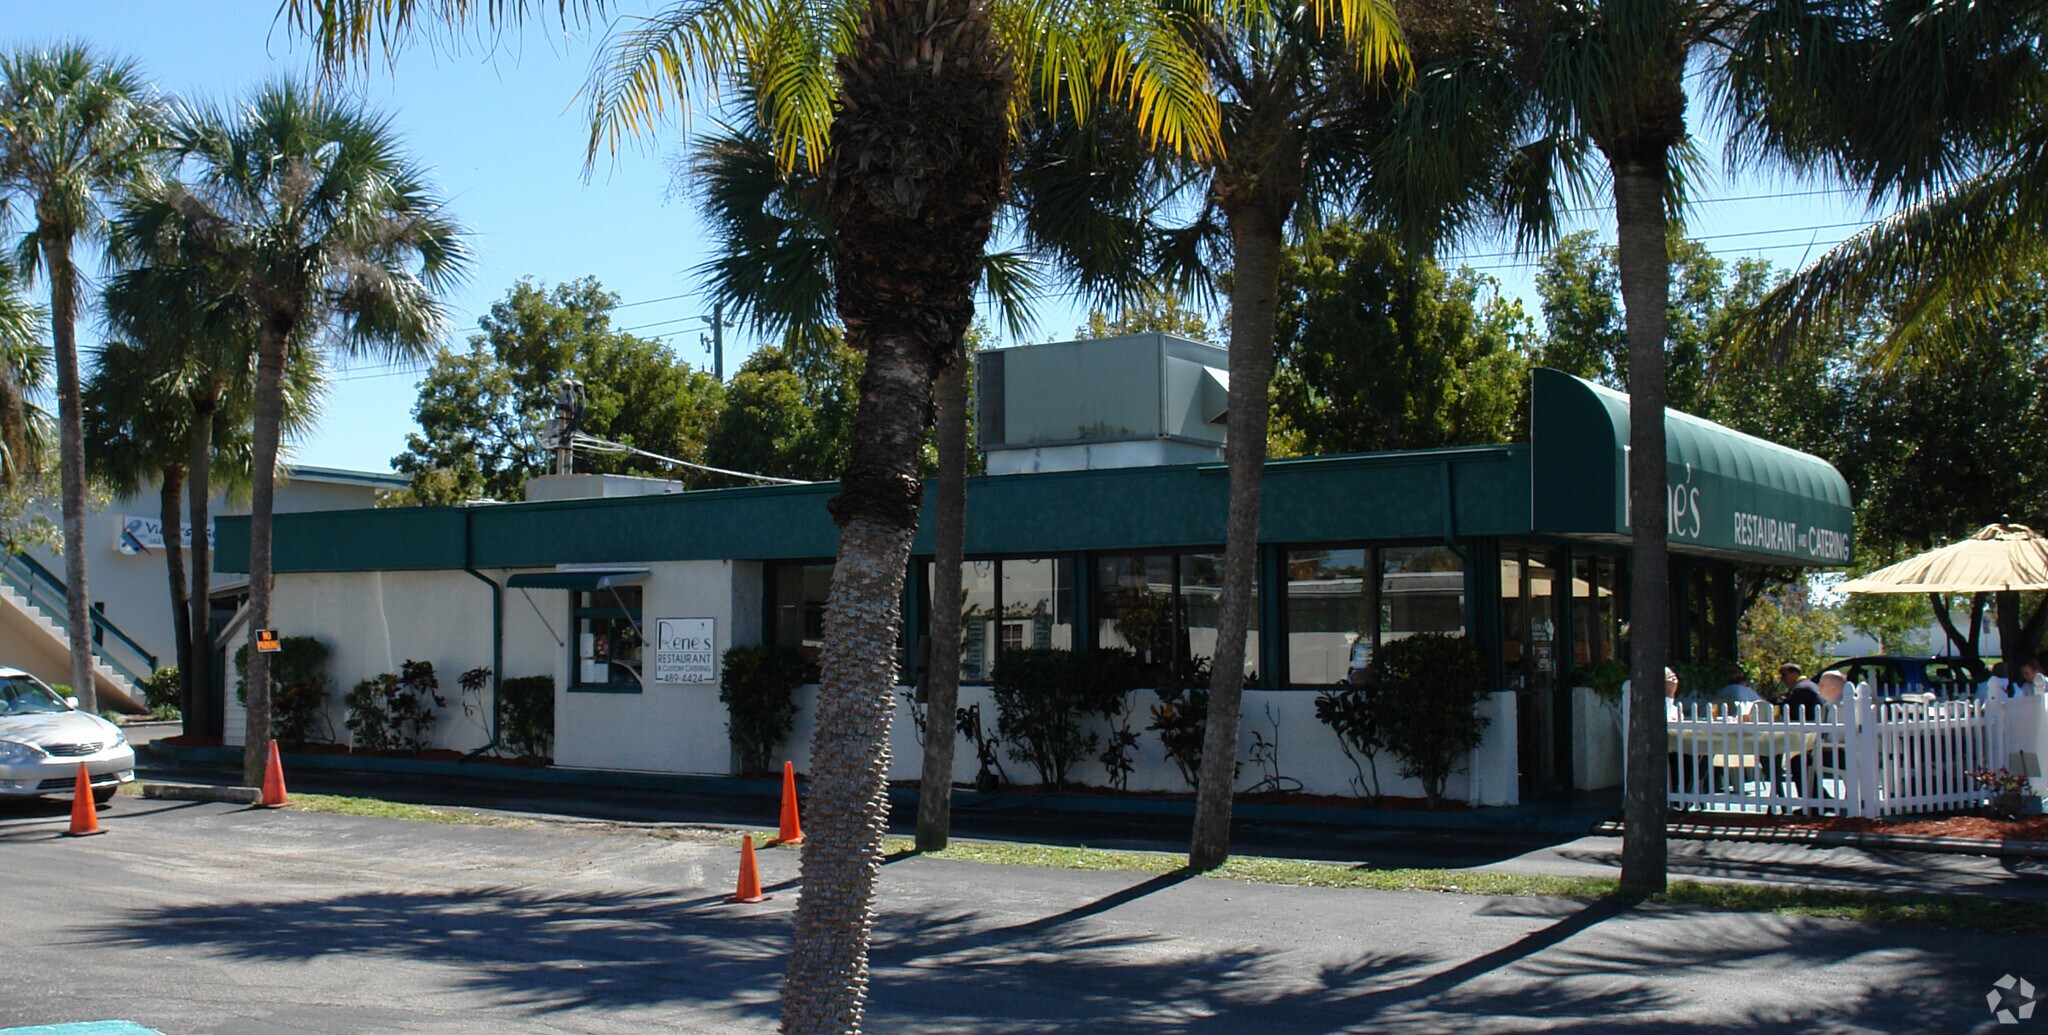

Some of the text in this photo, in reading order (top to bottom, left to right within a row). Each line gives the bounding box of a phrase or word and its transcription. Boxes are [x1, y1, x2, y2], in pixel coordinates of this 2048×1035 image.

[1734, 511, 1796, 553] RESTAURANT
[1808, 526, 1850, 561] CATERING
[262, 631, 272, 641] NO
[658, 621, 711, 650] Rene's
[258, 640, 279, 650] PARKING
[658, 653, 711, 664] RESTAURANT
[664, 673, 704, 683] 489-4424
